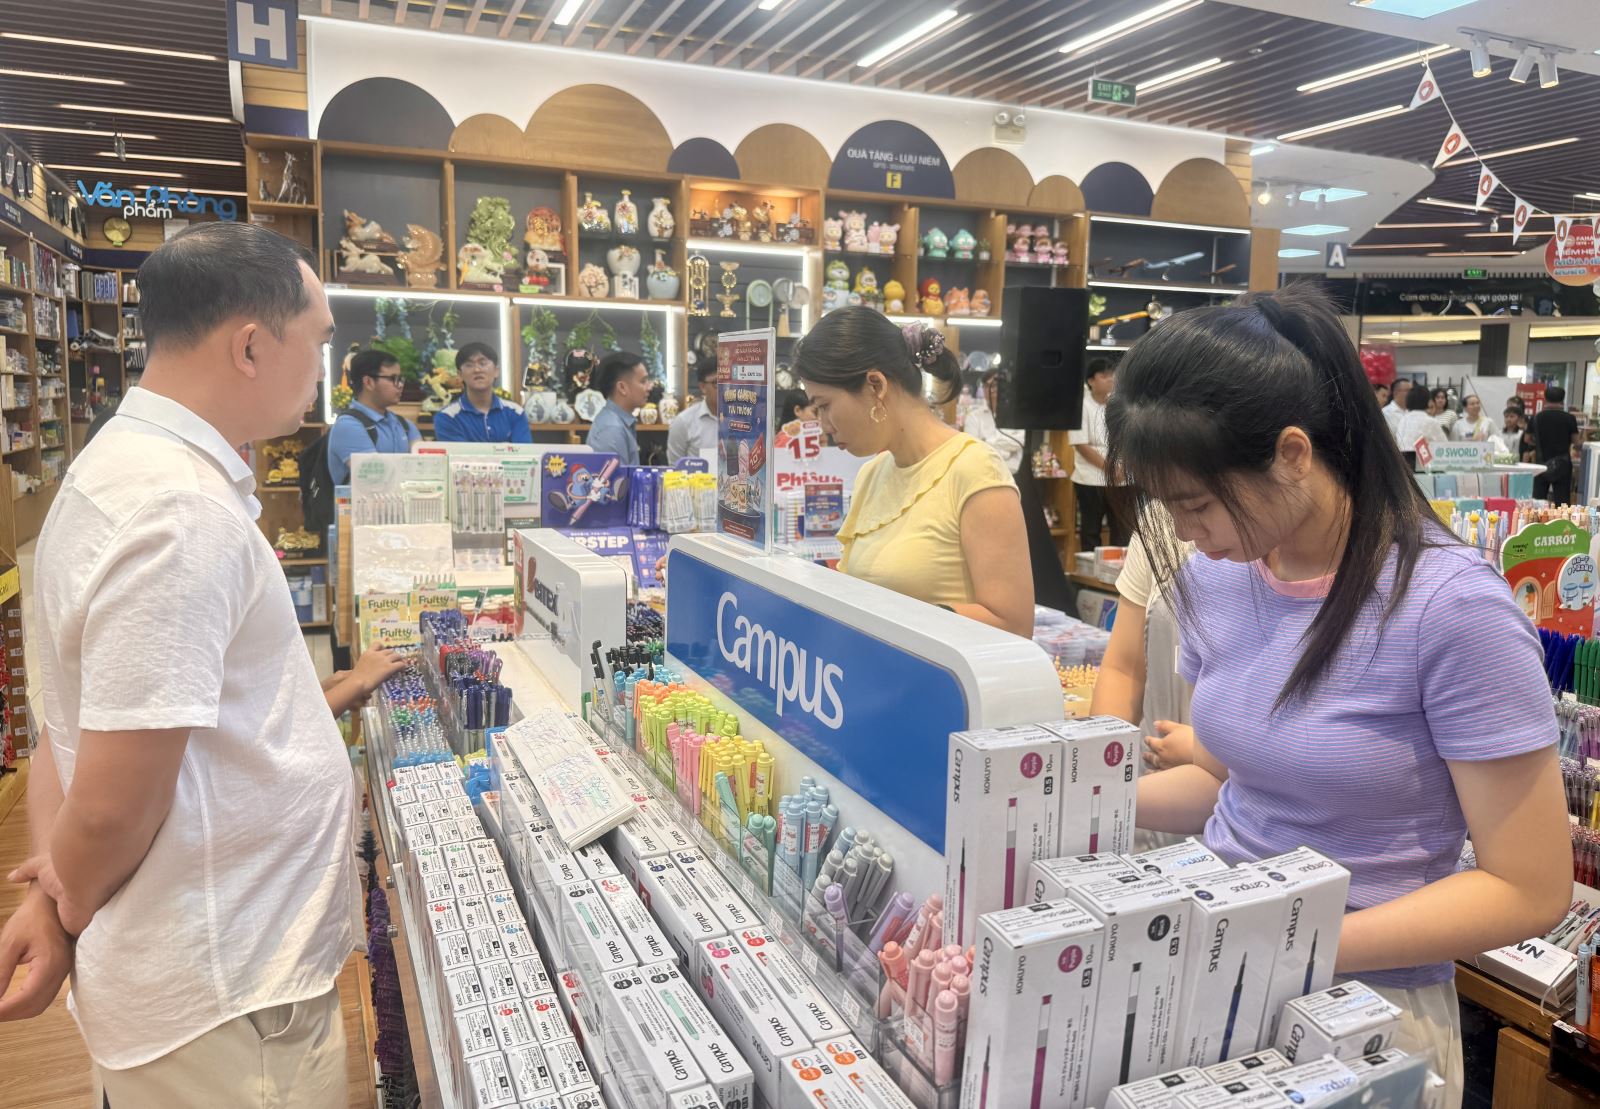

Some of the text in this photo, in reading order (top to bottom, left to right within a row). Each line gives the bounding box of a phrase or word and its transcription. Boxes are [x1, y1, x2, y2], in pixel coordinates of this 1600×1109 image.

[236, 2, 288, 61] H
[77, 179, 238, 222] Văn Phòng
[123, 200, 173, 220] phẩm
[1329, 245, 1345, 267] A
[788, 435, 820, 460] 15
[1445, 447, 1478, 458] SWORLD
[1533, 534, 1577, 548] CARROT
[368, 599, 400, 610] Fruitty
[418, 594, 450, 605] Fruitty
[379, 627, 413, 639] Fruitty
[716, 591, 844, 730] Campus
[953, 748, 964, 804] Campus
[984, 757, 992, 795] KOKUYO
[1071, 747, 1079, 784] KOKUYO
[640, 836, 657, 852] Campus
[559, 863, 574, 881] Campus
[1299, 860, 1335, 873] Campus
[1230, 880, 1271, 894] Campus
[694, 911, 714, 933] Campus
[726, 903, 748, 924] Campus
[1286, 897, 1303, 952] Campus
[606, 940, 624, 964] Campus
[644, 934, 664, 957] Campus
[1108, 923, 1118, 962] KOKUYO
[1208, 918, 1229, 974] Campus
[980, 936, 994, 996] Campus
[1016, 955, 1026, 996] KOKUYO
[806, 1002, 833, 1032] Campus
[767, 1017, 794, 1048] Campus
[1284, 1023, 1305, 1064] Camp
[664, 1049, 690, 1081] Campus
[707, 1042, 735, 1074] Campus
